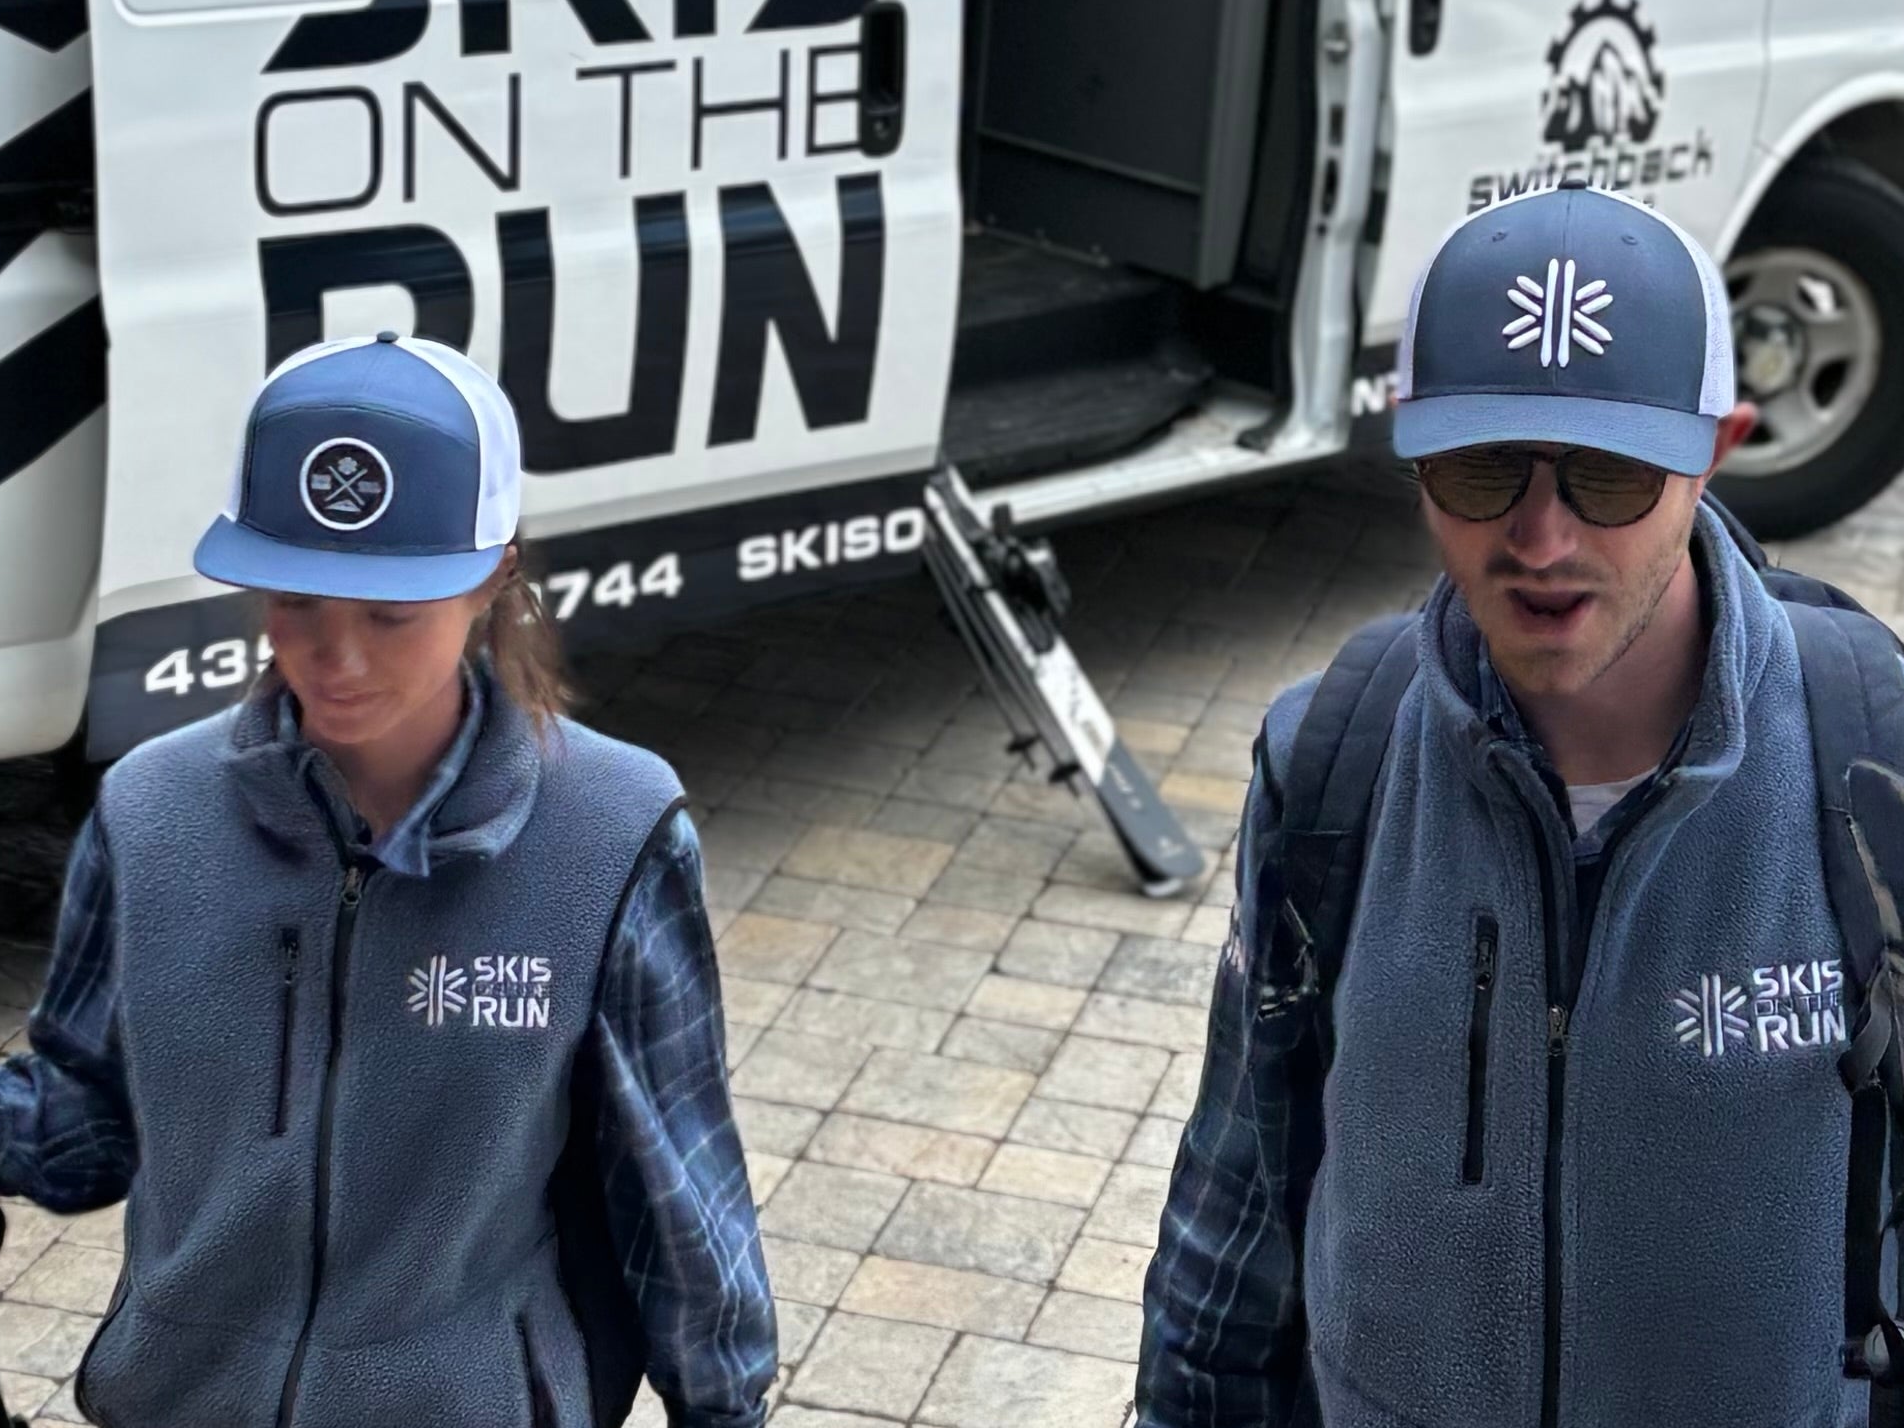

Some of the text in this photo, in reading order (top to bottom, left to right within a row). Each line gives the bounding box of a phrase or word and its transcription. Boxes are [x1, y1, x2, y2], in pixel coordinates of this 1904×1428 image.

[254, 43, 863, 218] ON THE
[473, 955, 553, 983] SKIS
[1752, 959, 1844, 998] SKIS
[471, 996, 551, 1029] RUN
[1754, 997, 1794, 1017] ON
[1755, 1006, 1846, 1053] RUN
